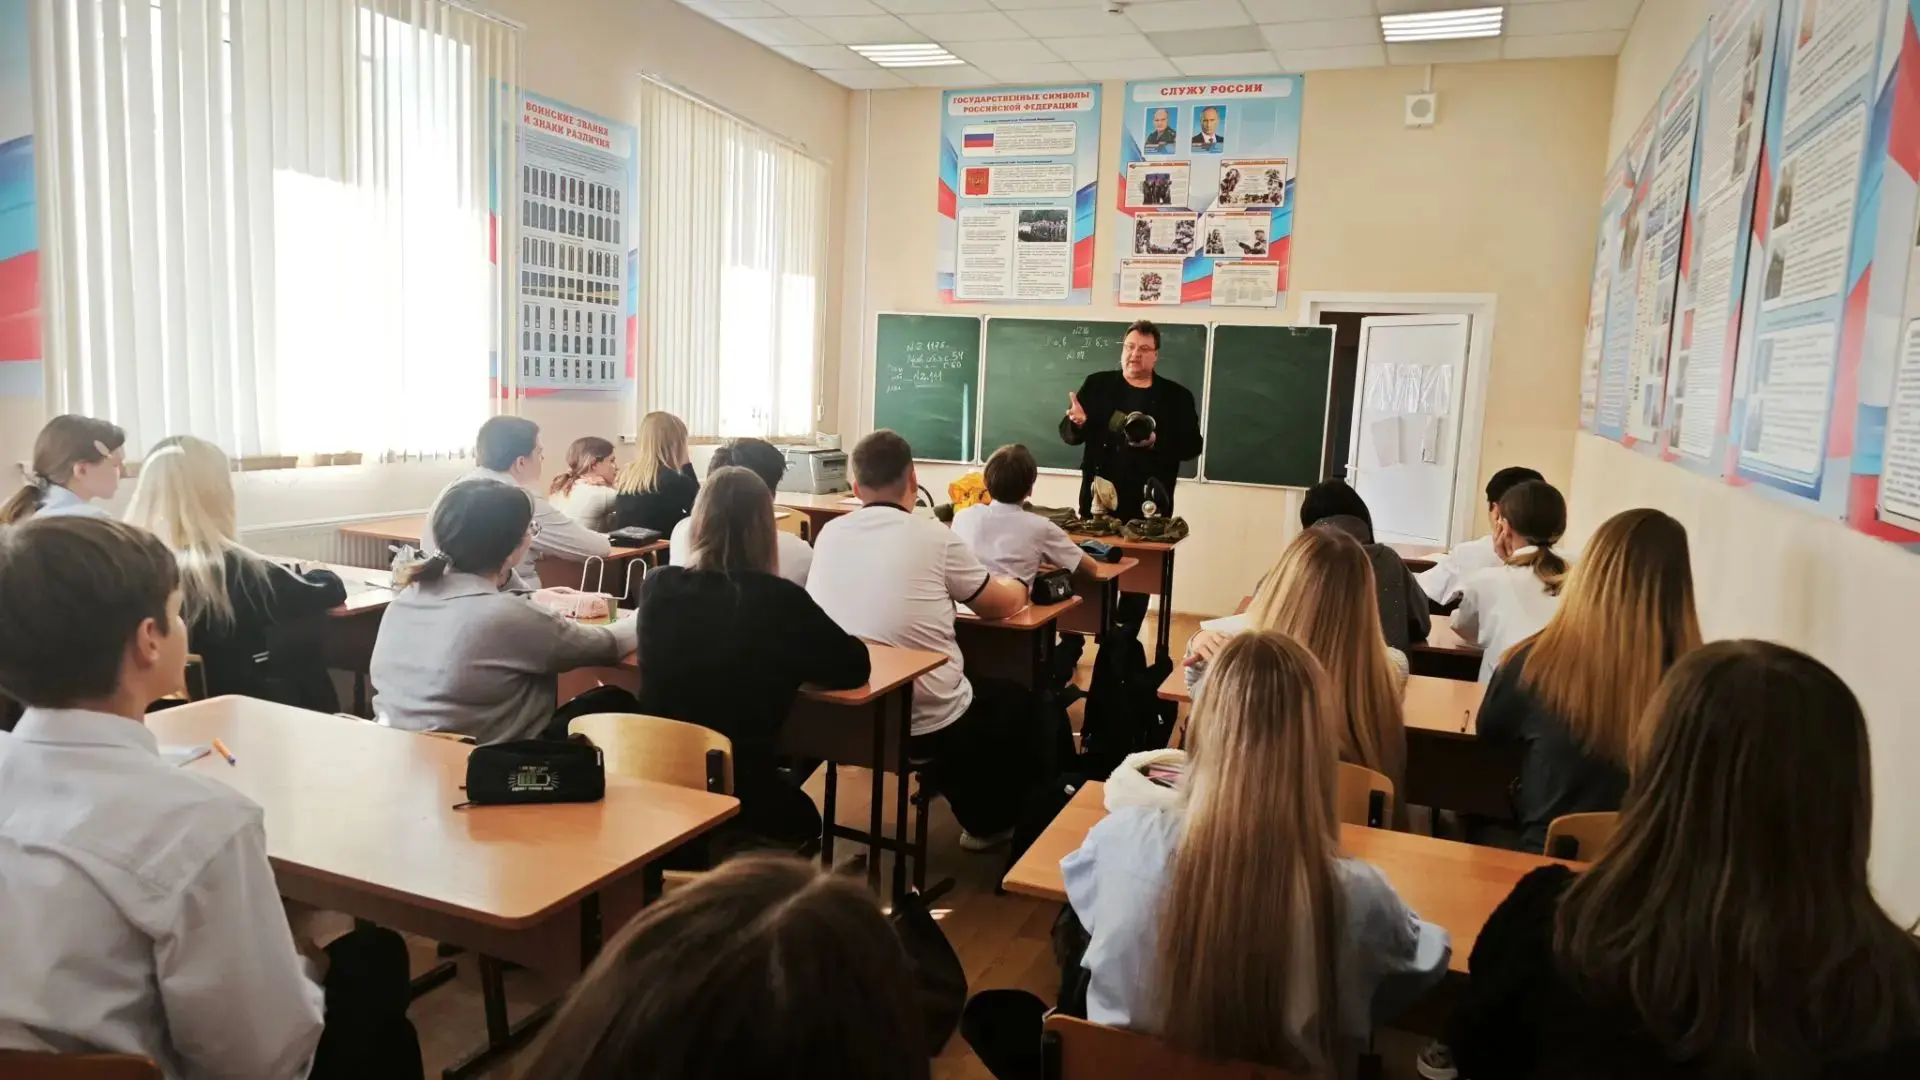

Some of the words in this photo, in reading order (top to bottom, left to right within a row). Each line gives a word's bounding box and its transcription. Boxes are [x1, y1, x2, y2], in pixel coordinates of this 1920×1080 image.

[1160, 86, 1206, 96] СЛУЖУ
[1210, 84, 1263, 94] РОССИИ
[953, 94, 1041, 104] ГОСУДАРСТВЕННЫЕ
[1042, 91, 1090, 101] СИМВОЛЫ
[963, 103, 1021, 113] РОССИЙСКОЙ
[1023, 102, 1078, 111] ФЕДЕРАЦИИ
[525, 101, 574, 125] ВОИНСКИЕ
[577, 118, 609, 136] ЗВАНИЯ
[523, 114, 531, 125] И
[533, 117, 564, 135] ЗНАКИ
[566, 127, 610, 149] РАЗЛИЧИЯ
